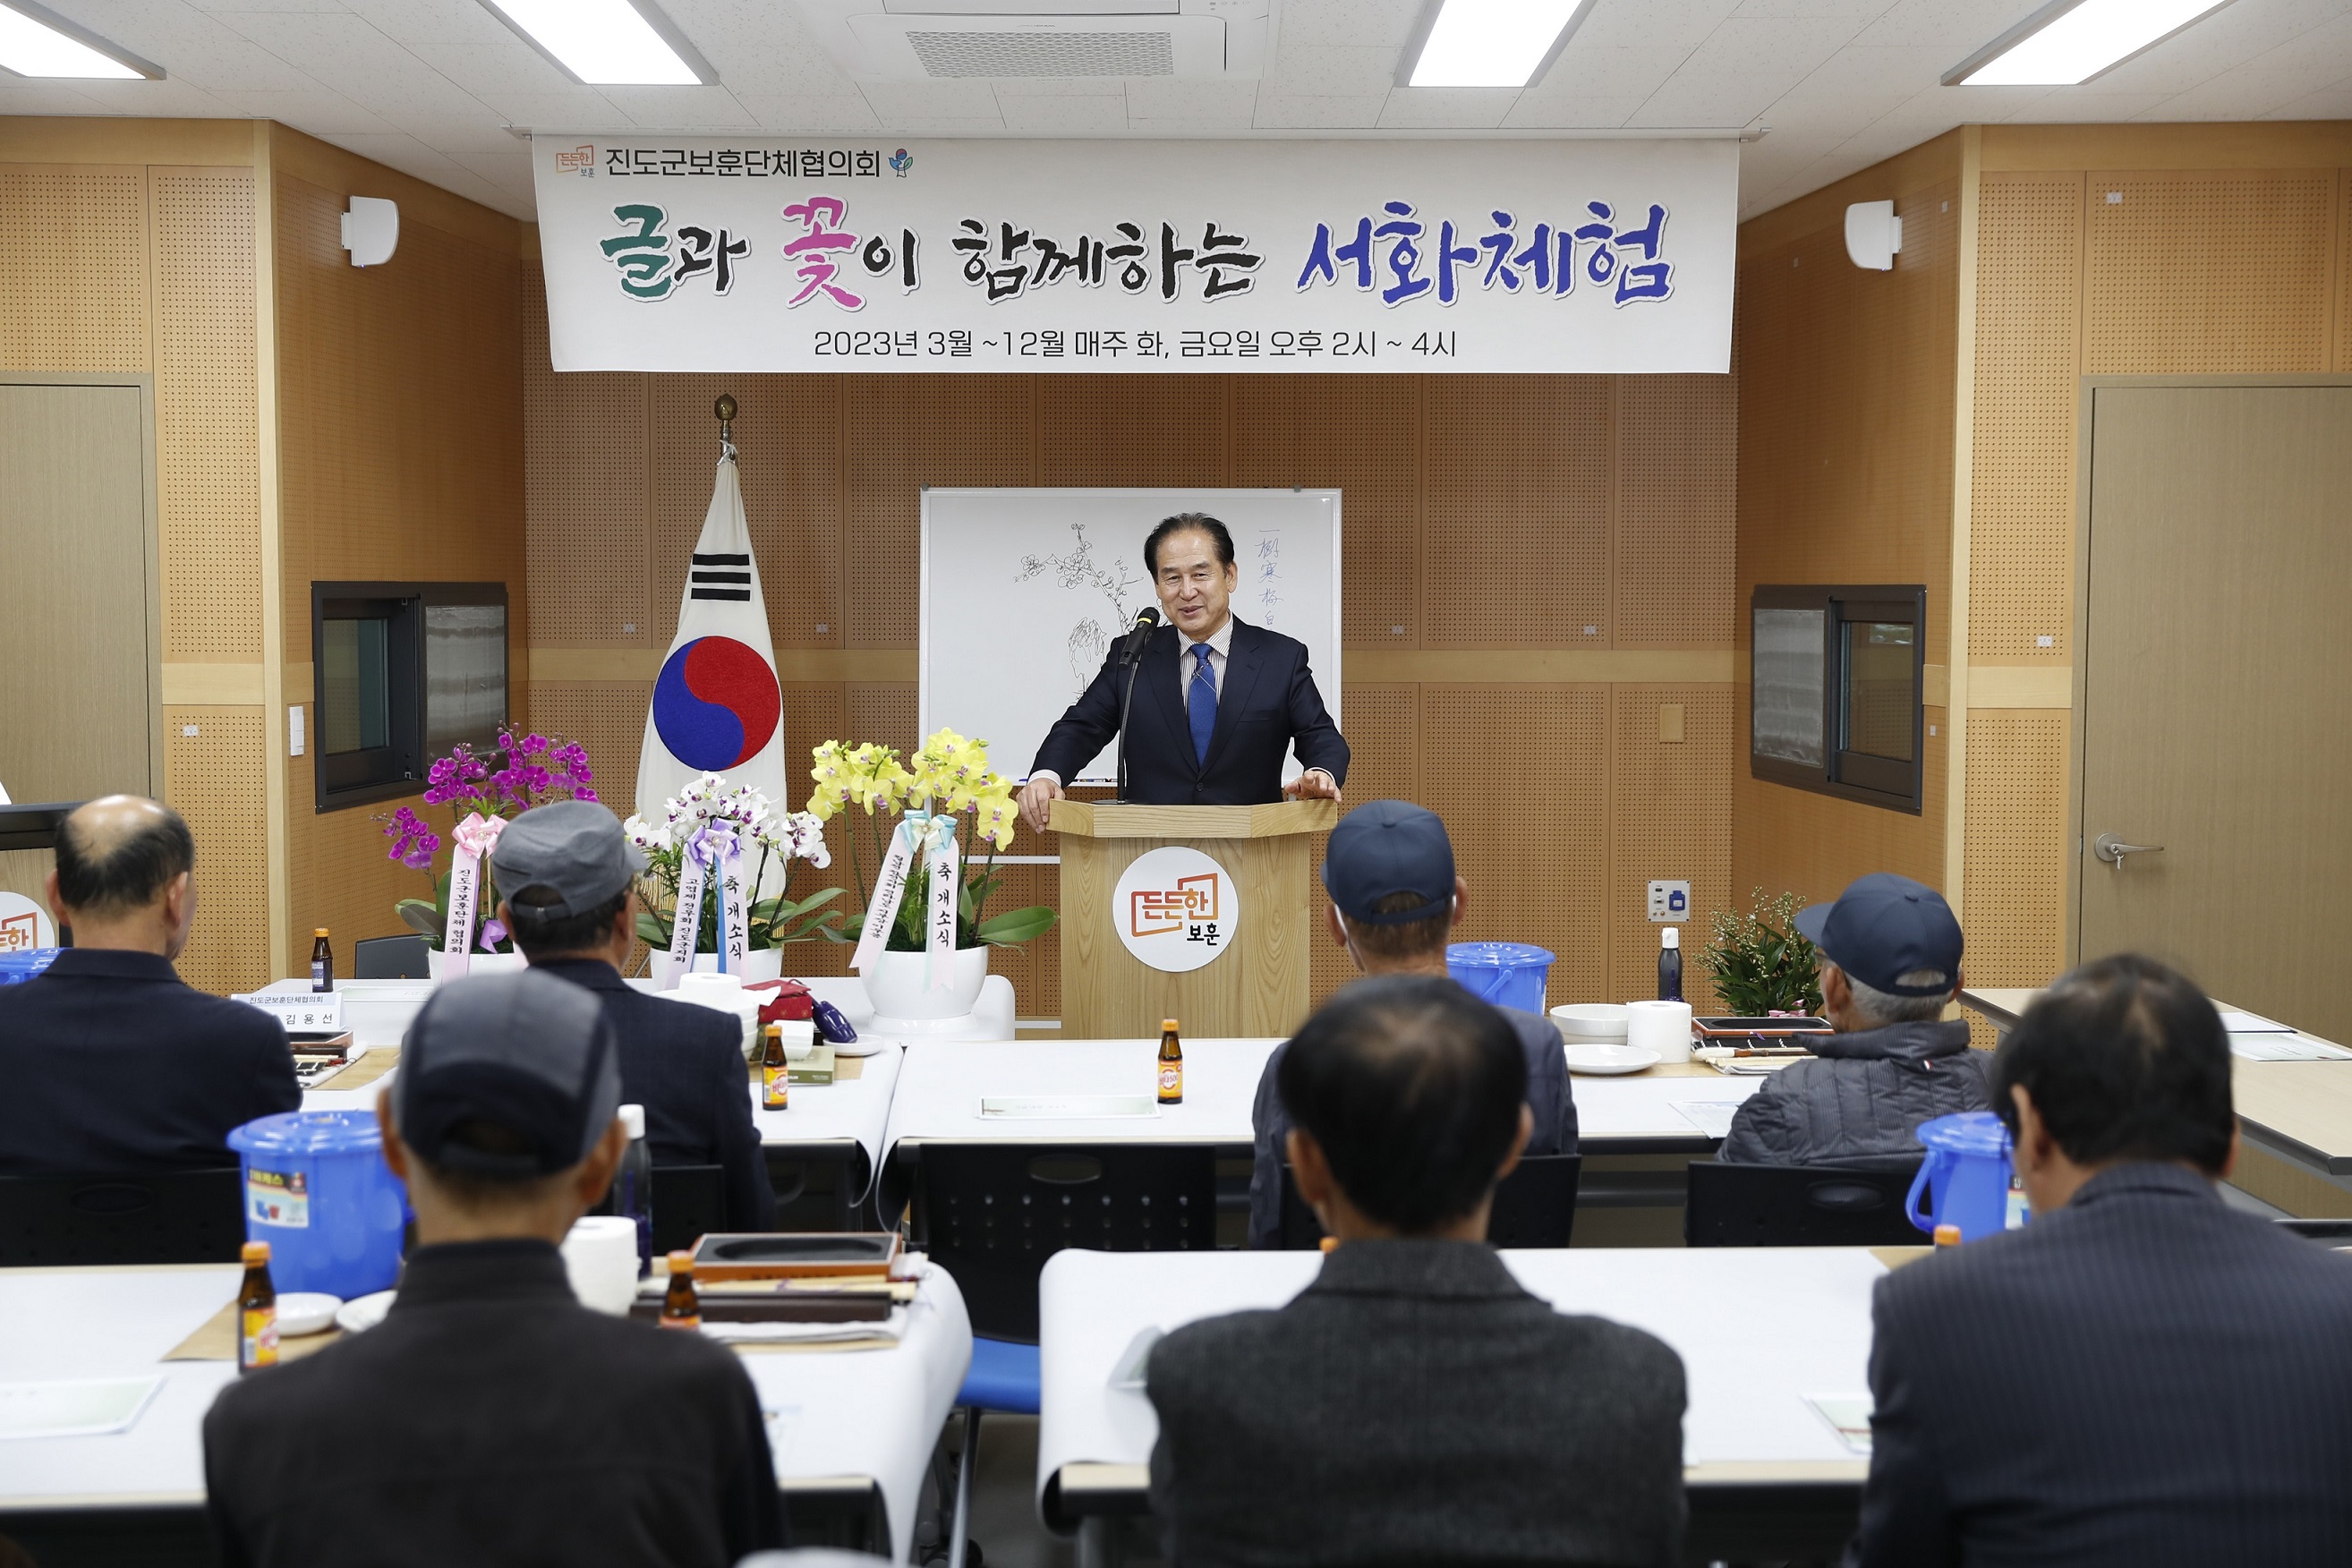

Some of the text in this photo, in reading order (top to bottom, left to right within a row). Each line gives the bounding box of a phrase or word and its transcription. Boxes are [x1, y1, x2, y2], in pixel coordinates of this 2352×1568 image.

[581, 167, 595, 178] 보훈
[605, 149, 880, 178] 진도군보훈단체협의회
[599, 196, 1674, 311] 글과 꽃이 함께하는 서화체험
[814, 330, 917, 356] 2023년
[928, 330, 972, 357] 3월
[1075, 330, 1129, 358] 매주
[1137, 330, 1169, 360] 화,
[1180, 330, 1260, 357] 금요일
[1269, 329, 1324, 357] 오후
[1333, 330, 1376, 357] 2시
[1411, 330, 1455, 357] 4시
[684, 878, 700, 900] 고엽제
[1186, 923, 1221, 946] 보훈
[249, 995, 324, 1005] 진도군보훈단체협의회
